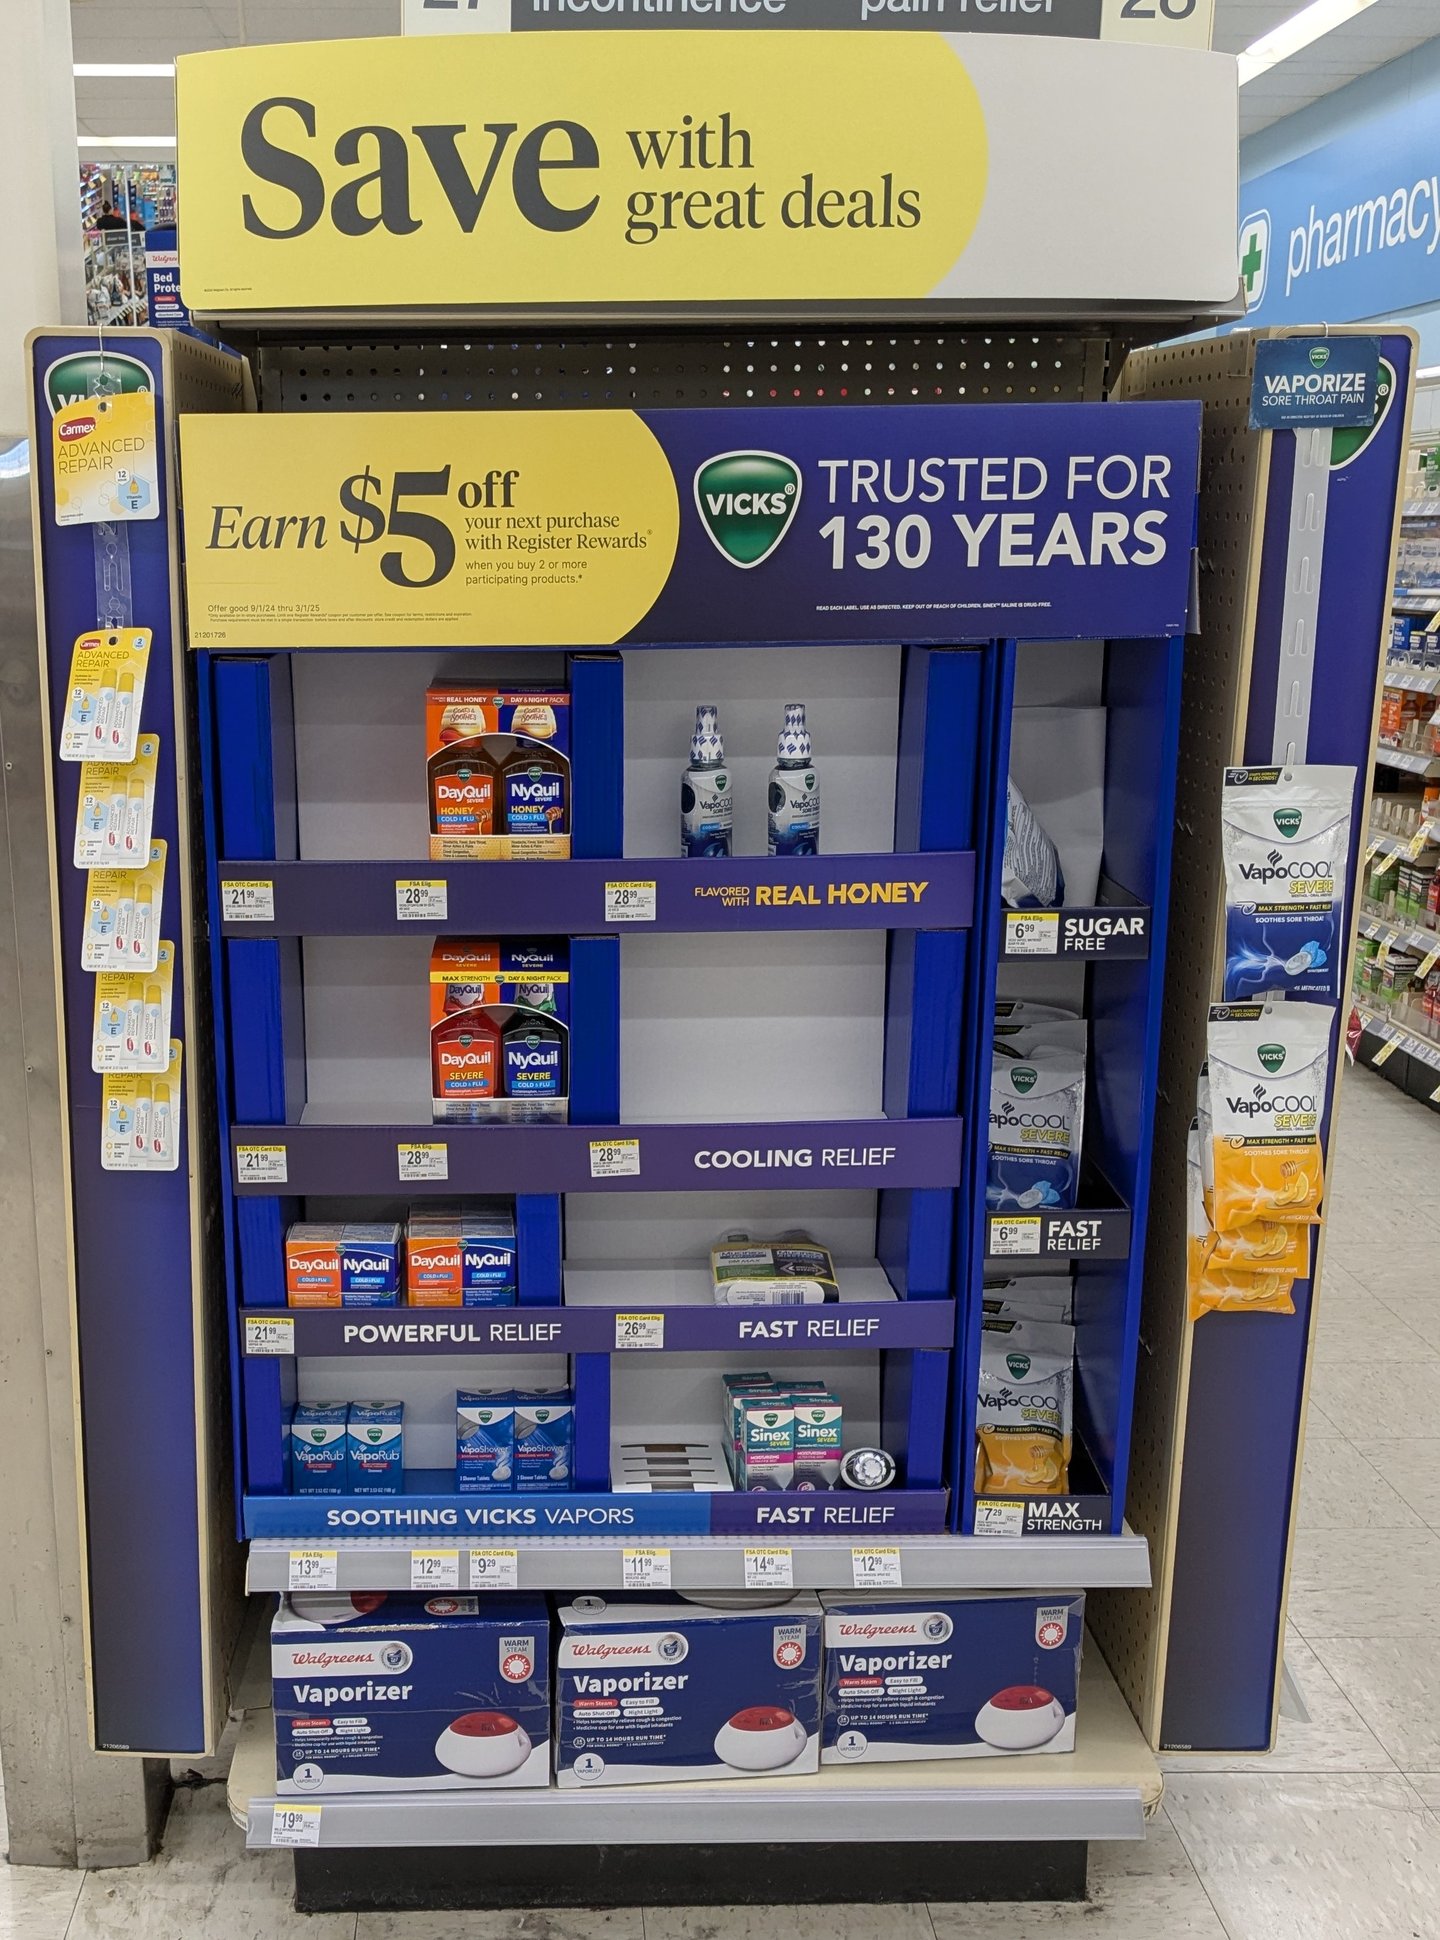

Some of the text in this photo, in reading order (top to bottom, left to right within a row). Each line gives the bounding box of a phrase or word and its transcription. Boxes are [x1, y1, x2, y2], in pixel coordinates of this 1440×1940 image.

[626, 112, 754, 169] with
[241, 97, 600, 239] Save
[625, 173, 921, 245] great deals
[1285, 176, 1440, 297] pharmacy
[153, 273, 172, 282] Bed
[1264, 373, 1366, 393] VAPORIZE
[1262, 393, 1364, 406] SORE THROAT PAIN
[59, 422, 96, 436] Carmex
[58, 437, 145, 459] ADVANCED
[58, 456, 113, 475] REPAIR
[818, 455, 1172, 503] TRUSTED FOR
[206, 464, 520, 588] Earn $5 off
[464, 512, 620, 533] your next purchase
[465, 534, 502, 549] with
[506, 533, 573, 553] Register
[819, 509, 1168, 570] 130 YEARS
[466, 561, 493, 570] when
[496, 562, 514, 571] you
[517, 560, 536, 571] buy
[539, 560, 545, 569] 2
[562, 561, 587, 569] more
[466, 575, 528, 586] participating
[208, 604, 320, 613] Offer good 9/1/24 thru 3/1/25
[77, 651, 130, 660] ADVANCED
[76, 660, 110, 668] REPAIR
[86, 767, 120, 776] REPAIR
[438, 784, 490, 802] DayQuil
[511, 782, 559, 801] NyQuil
[441, 807, 474, 815] HONEY
[511, 805, 544, 813] HONEY
[1275, 818, 1300, 826] VICKS
[93, 870, 127, 879] REPAIR
[1239, 861, 1333, 885] VapoCOOL
[694, 887, 749, 897] FLAVORED
[1289, 880, 1334, 894] SEVERE
[722, 882, 929, 907] WITH REAL HONEY
[1064, 918, 1144, 936] SUGAR
[1064, 938, 1106, 951] FREE
[442, 953, 491, 962] DayQuil
[511, 953, 554, 962] NyQuil
[101, 973, 136, 981] REPAIR
[449, 985, 482, 995] DayQuil
[441, 1052, 491, 1068] DayQuil
[508, 1051, 558, 1069] NyQuil
[1259, 1053, 1284, 1061] VICKS
[450, 1071, 484, 1080] SEVERE
[517, 1072, 551, 1080] SEVERE
[1012, 1074, 1035, 1083] VICKS
[1226, 1095, 1317, 1118] VapoCOOL
[989, 1112, 1070, 1130] apoCOOL
[1020, 1129, 1070, 1142] SEVERE
[694, 1147, 896, 1169] COOLING RELIEF
[1048, 1220, 1102, 1237] FAST
[1047, 1239, 1101, 1251] RELIEF
[289, 1259, 339, 1273] DayQuil
[343, 1258, 390, 1273] NyQuil
[411, 1255, 460, 1269] DayQuil
[465, 1253, 511, 1268] NyQuil
[344, 1323, 562, 1344] POWERFUL RELIEF
[739, 1319, 880, 1338] FAST RELIEF
[1008, 1360, 1029, 1369] VICKS
[751, 1429, 790, 1442] Sinex
[798, 1425, 837, 1438] Sinex
[460, 1445, 508, 1455] VapoShower
[517, 1444, 565, 1454] VapoShower
[295, 1450, 344, 1463] VapoRub
[350, 1450, 399, 1463] VapoRub
[327, 1507, 634, 1526] SOOTHING VICKS VAPORS
[757, 1506, 896, 1523] FAST RELIEF
[1028, 1502, 1080, 1518] MAX
[1027, 1519, 1102, 1531] STRENGTH
[778, 1628, 801, 1636] WARM
[839, 1623, 917, 1639] Walgreens
[504, 1639, 529, 1647] WARM
[572, 1644, 652, 1659] Walgreens
[292, 1652, 374, 1668] Walgreens
[840, 1651, 953, 1675] Vaporizer
[573, 1671, 689, 1696] Vaporizer
[293, 1681, 413, 1706] Vaporizer
